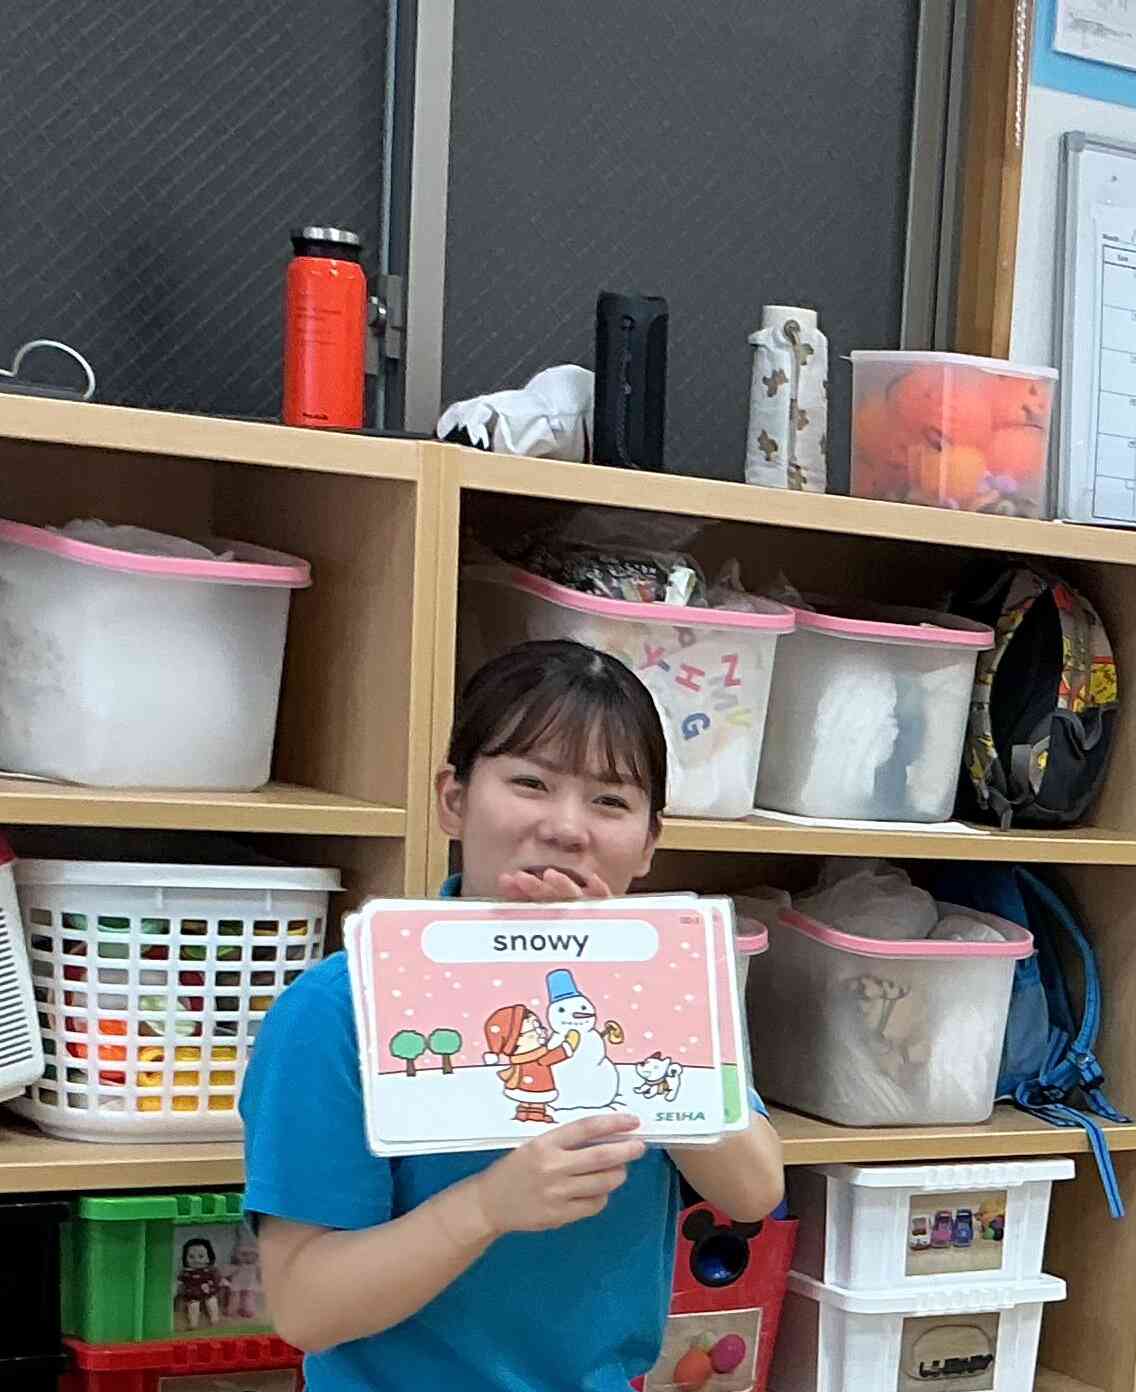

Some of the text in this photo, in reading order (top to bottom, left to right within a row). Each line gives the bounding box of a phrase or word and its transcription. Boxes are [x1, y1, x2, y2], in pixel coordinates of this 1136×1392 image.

[681, 712, 711, 741] G
[493, 933, 589, 957] snowy
[655, 1111, 706, 1122] SEIHA
